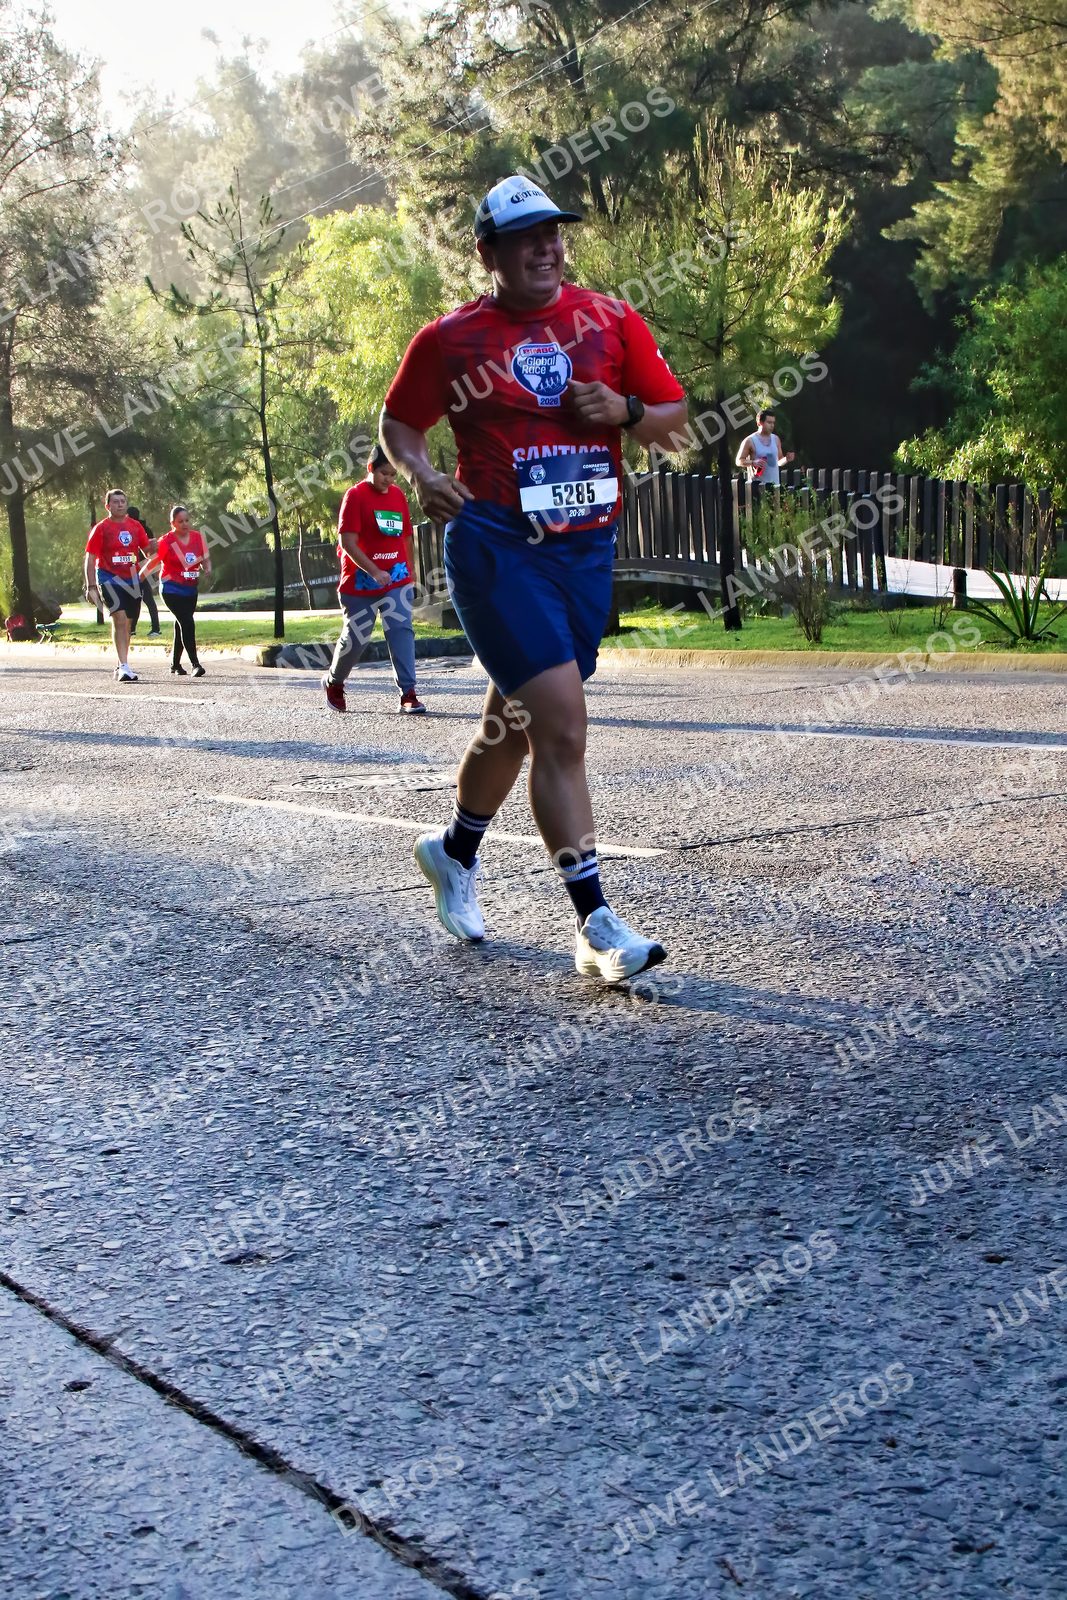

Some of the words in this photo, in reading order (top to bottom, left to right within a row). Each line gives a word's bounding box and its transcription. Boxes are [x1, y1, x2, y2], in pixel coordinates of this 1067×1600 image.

[526, 355, 556, 366] Global
[521, 365, 547, 375] Race
[551, 481, 596, 507] 5285
[386, 520, 395, 528] 413
